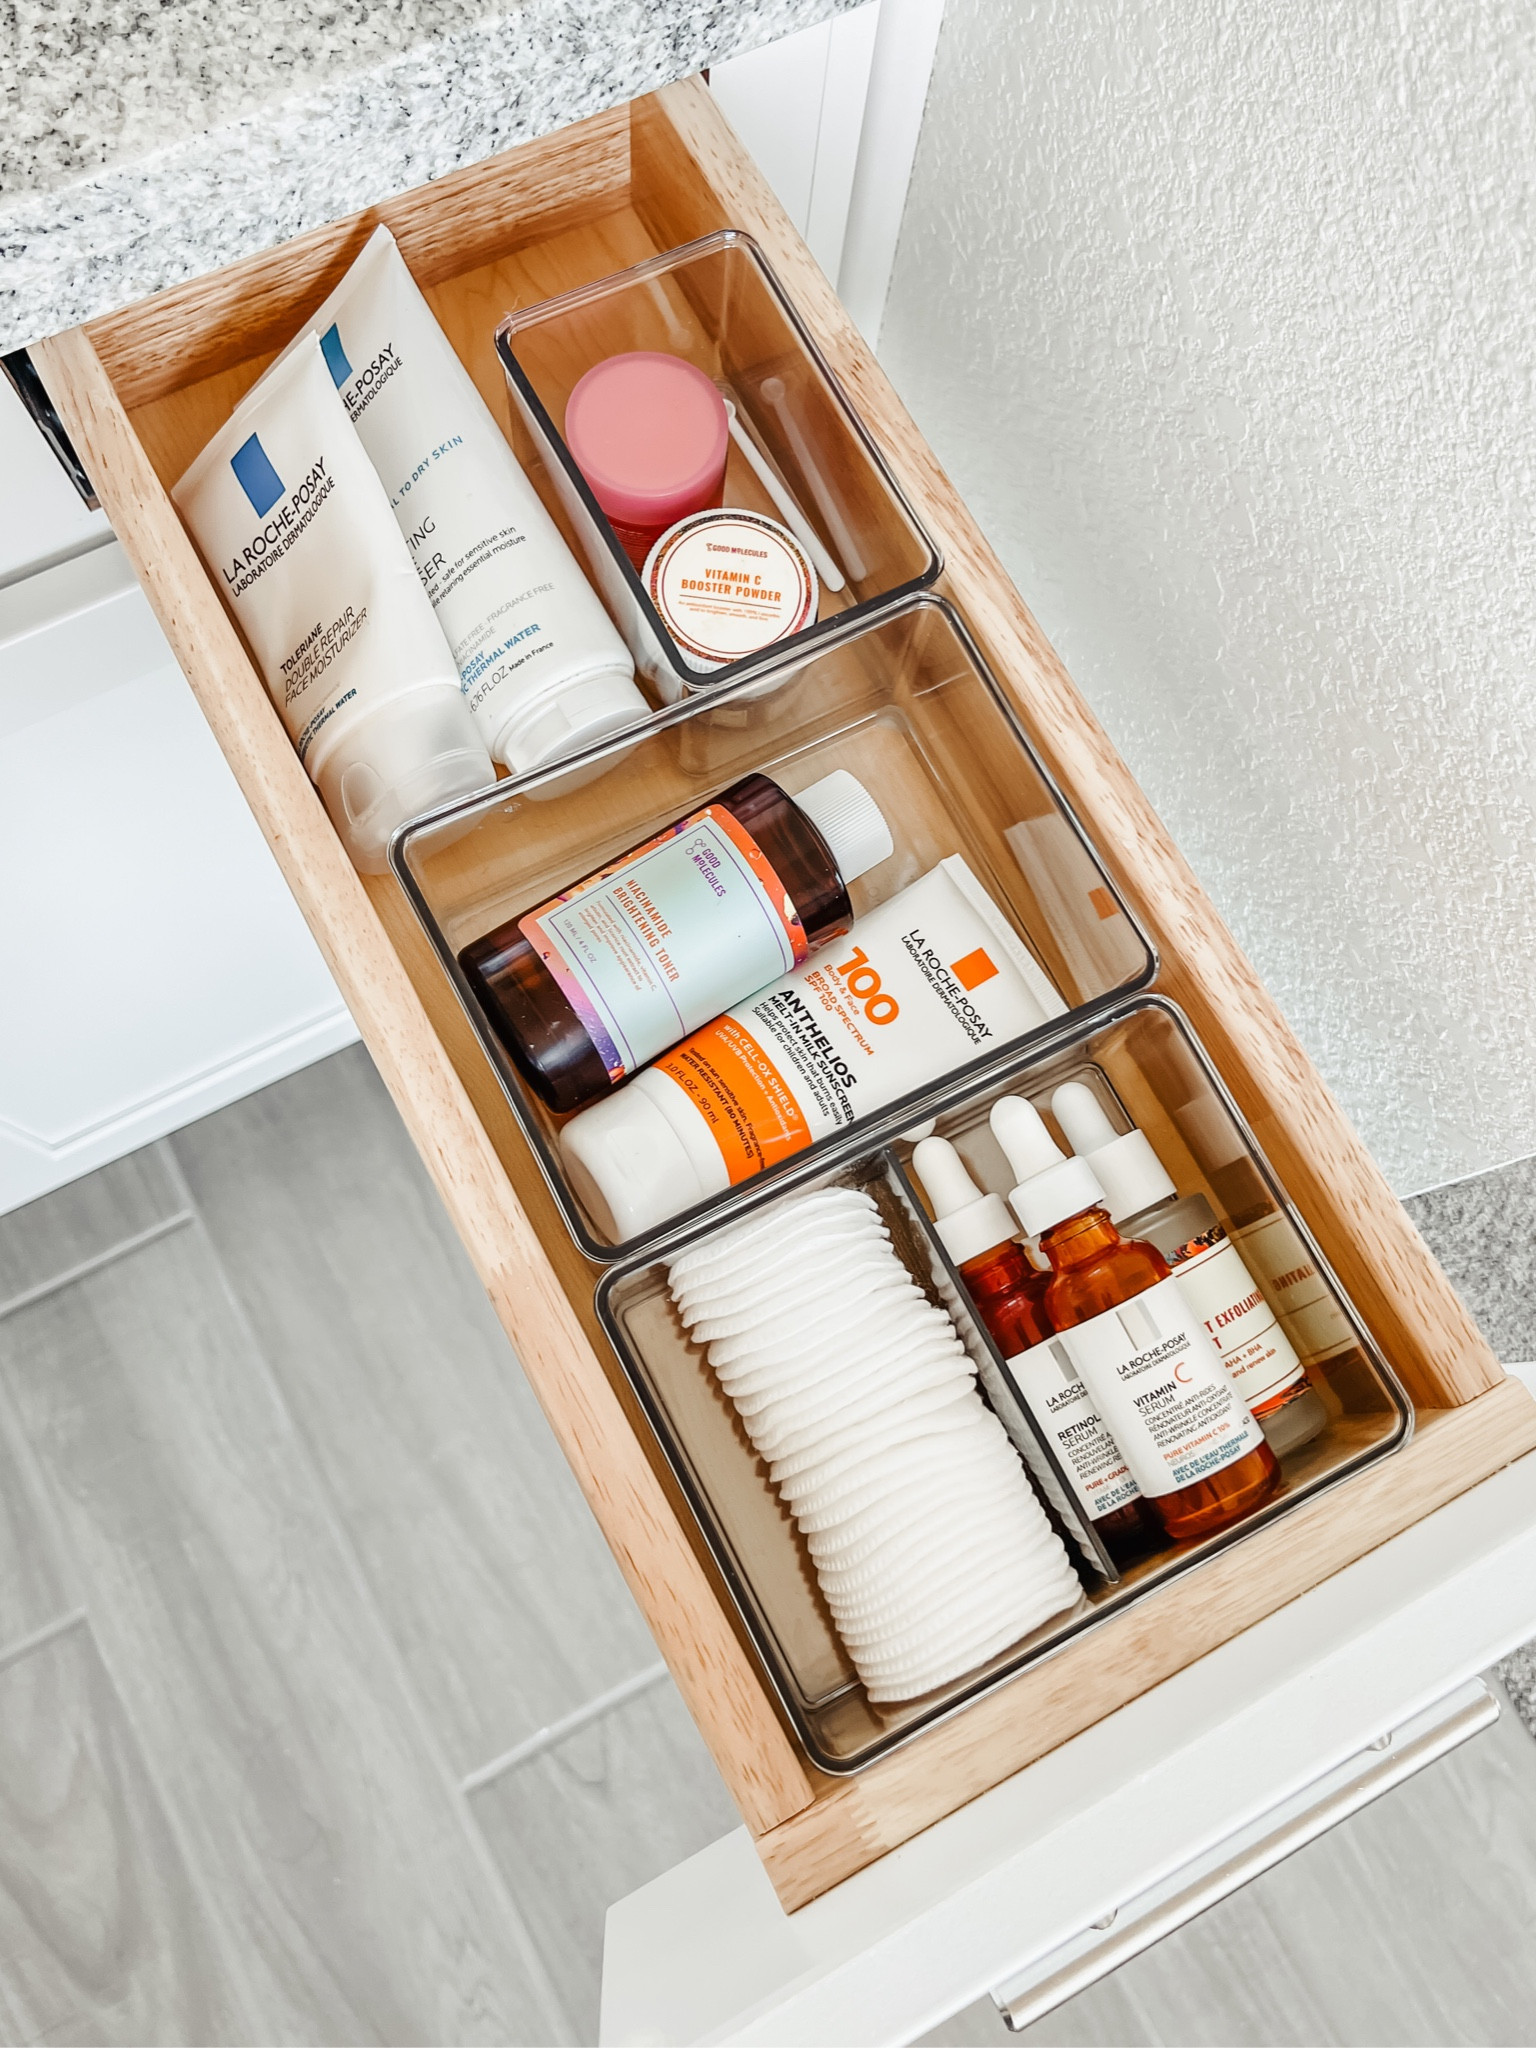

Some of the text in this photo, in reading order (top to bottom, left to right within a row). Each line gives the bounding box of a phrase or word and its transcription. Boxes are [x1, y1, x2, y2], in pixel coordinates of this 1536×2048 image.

[399, 434, 462, 496] TO DRY SKIN
[223, 456, 328, 584] LA ROCHE-POSAY
[232, 476, 334, 597] LABORATOIRE DERMATOLOGIQUE
[439, 574, 464, 600] retaining
[462, 549, 491, 576] essential
[492, 533, 526, 553] moisture
[441, 526, 516, 582] safe for sensitive skin
[705, 569, 760, 584] VITAMIN C
[468, 581, 554, 641] FREE FRAGRANCE FREE
[681, 579, 780, 601] BOOSTER POWDER
[280, 622, 323, 676] TOLERIANE
[283, 643, 322, 693] DOUBLE
[318, 605, 355, 651] REPAIR
[283, 675, 310, 707] FACE
[307, 608, 368, 683] MOISTURIZER
[467, 645, 504, 686] THERMAL
[504, 622, 540, 649] WATER
[509, 657, 524, 671] Made
[532, 641, 553, 655] France
[312, 706, 334, 734] THERMAL
[336, 687, 357, 708] WATER
[701, 848, 720, 868] GOOD
[626, 878, 671, 938] NIACINAMIDE
[581, 944, 589, 952] FL
[612, 887, 659, 947] BRIGHTENING
[655, 947, 679, 981] TONER
[804, 974, 832, 1011] SPF 100
[824, 964, 860, 1015] Body & Face
[837, 946, 899, 1026] 100
[901, 936, 980, 1044] LABORATOIRE DERMATOLOGIQUE
[909, 928, 992, 1040] LA ROCHE-POSAY
[768, 995, 802, 1034] MELT-IN
[799, 1034, 820, 1060] MILK
[811, 971, 873, 1055] BROAD SPECTRUM
[723, 1024, 740, 1039] with
[738, 1037, 771, 1077] CELL-OX
[778, 986, 857, 1089] ANTHELIOS
[751, 1006, 830, 1117] Suitable for children and adults
[759, 1001, 844, 1126] Helps protect skin that burns easily
[679, 1051, 754, 1158] WATER RESISTANT (80 MINUTES)
[703, 1060, 711, 1068] on
[709, 1067, 720, 1079] sun
[718, 1079, 739, 1106] sensitive
[736, 1106, 748, 1122] skin.
[715, 1029, 791, 1141] UVA/UVB Protection Antioxidants
[698, 1098, 711, 1110] 90
[706, 1110, 719, 1123] ml
[1116, 1332, 1187, 1375] LA ROCHE-POSAY
[1224, 1342, 1262, 1368] AHA BHA
[1231, 1365, 1245, 1378] and
[1246, 1355, 1265, 1369] renew
[1045, 1395, 1058, 1407] LA
[1133, 1362, 1193, 1408] VITAMIN C
[1138, 1393, 1175, 1417] SERUM
[1144, 1383, 1216, 1426] CONCENTRÉ ANTI-RIDES
[1057, 1412, 1102, 1441] RETINOL
[1062, 1426, 1097, 1449] SERUM
[1152, 1414, 1198, 1441] ANTI-WRINKLE
[1156, 1424, 1197, 1448] RENOVATING
[1163, 1447, 1183, 1460] PURE
[1182, 1432, 1212, 1451] VITAMIN
[1217, 1422, 1230, 1431] 10%
[1075, 1446, 1118, 1472] ANTI-WRINKLE
[1079, 1458, 1112, 1479] RENEWING
[1171, 1464, 1189, 1476] AVEC
[1189, 1459, 1199, 1468] DE
[1199, 1449, 1219, 1462] L'EAU
[1219, 1430, 1248, 1452] THERMALE
[1195, 1444, 1241, 1474] ROCHE-POSAY
[1085, 1479, 1103, 1491] PURE
[1094, 1493, 1110, 1505] AVEC
[1110, 1488, 1119, 1496] DE
[1097, 1503, 1106, 1511] DE
